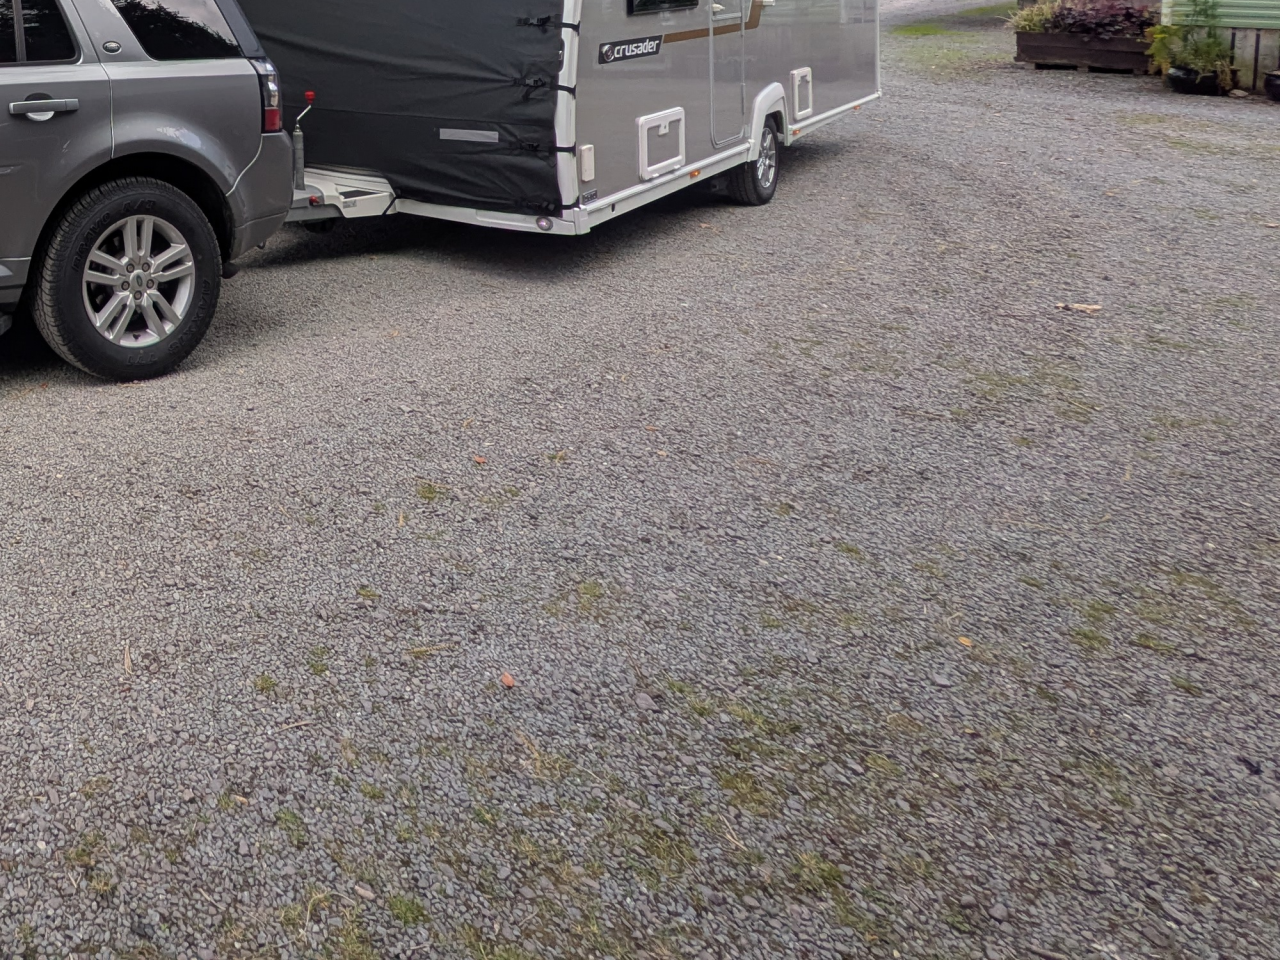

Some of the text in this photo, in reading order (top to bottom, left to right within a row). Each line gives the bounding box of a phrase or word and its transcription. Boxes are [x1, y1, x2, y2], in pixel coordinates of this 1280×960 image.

[614, 39, 660, 58] crusader
[71, 212, 111, 272] BRAVO
[168, 279, 211, 353] MAXXIS
